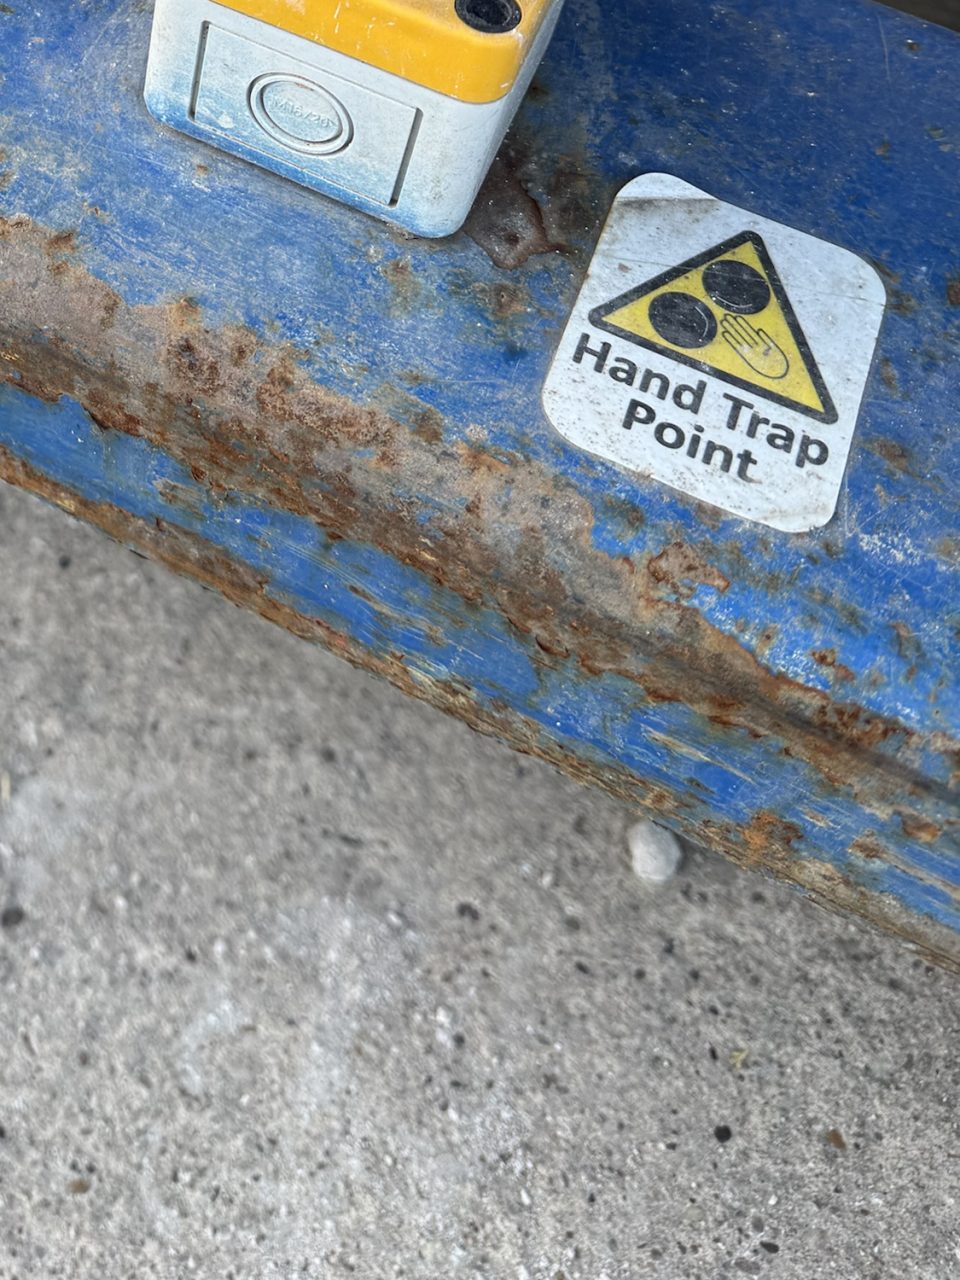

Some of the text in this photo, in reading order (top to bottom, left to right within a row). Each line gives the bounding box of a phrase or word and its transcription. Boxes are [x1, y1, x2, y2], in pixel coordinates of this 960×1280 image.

[572, 332, 830, 469] Hand Trap
[622, 398, 760, 483] Point
